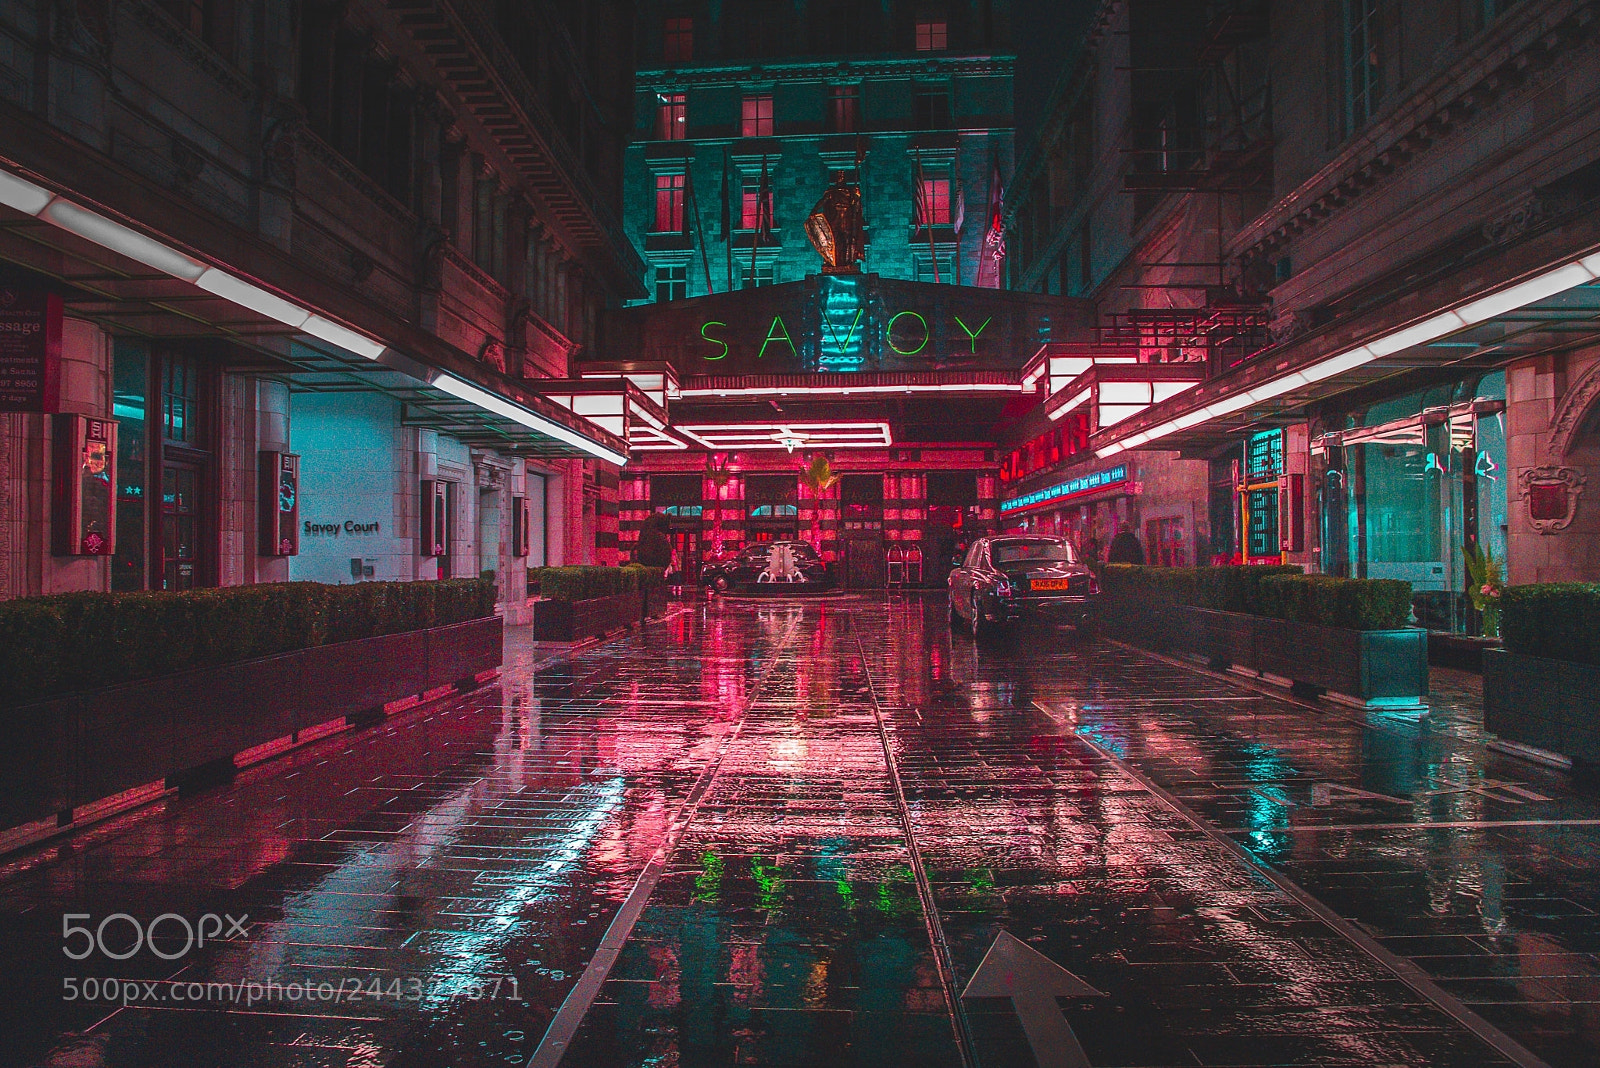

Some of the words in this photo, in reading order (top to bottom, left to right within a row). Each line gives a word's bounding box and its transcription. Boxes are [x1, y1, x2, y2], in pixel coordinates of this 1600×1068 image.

[700, 307, 992, 361] SAVOY
[304, 520, 342, 538] Savoy
[344, 520, 379, 533] Court
